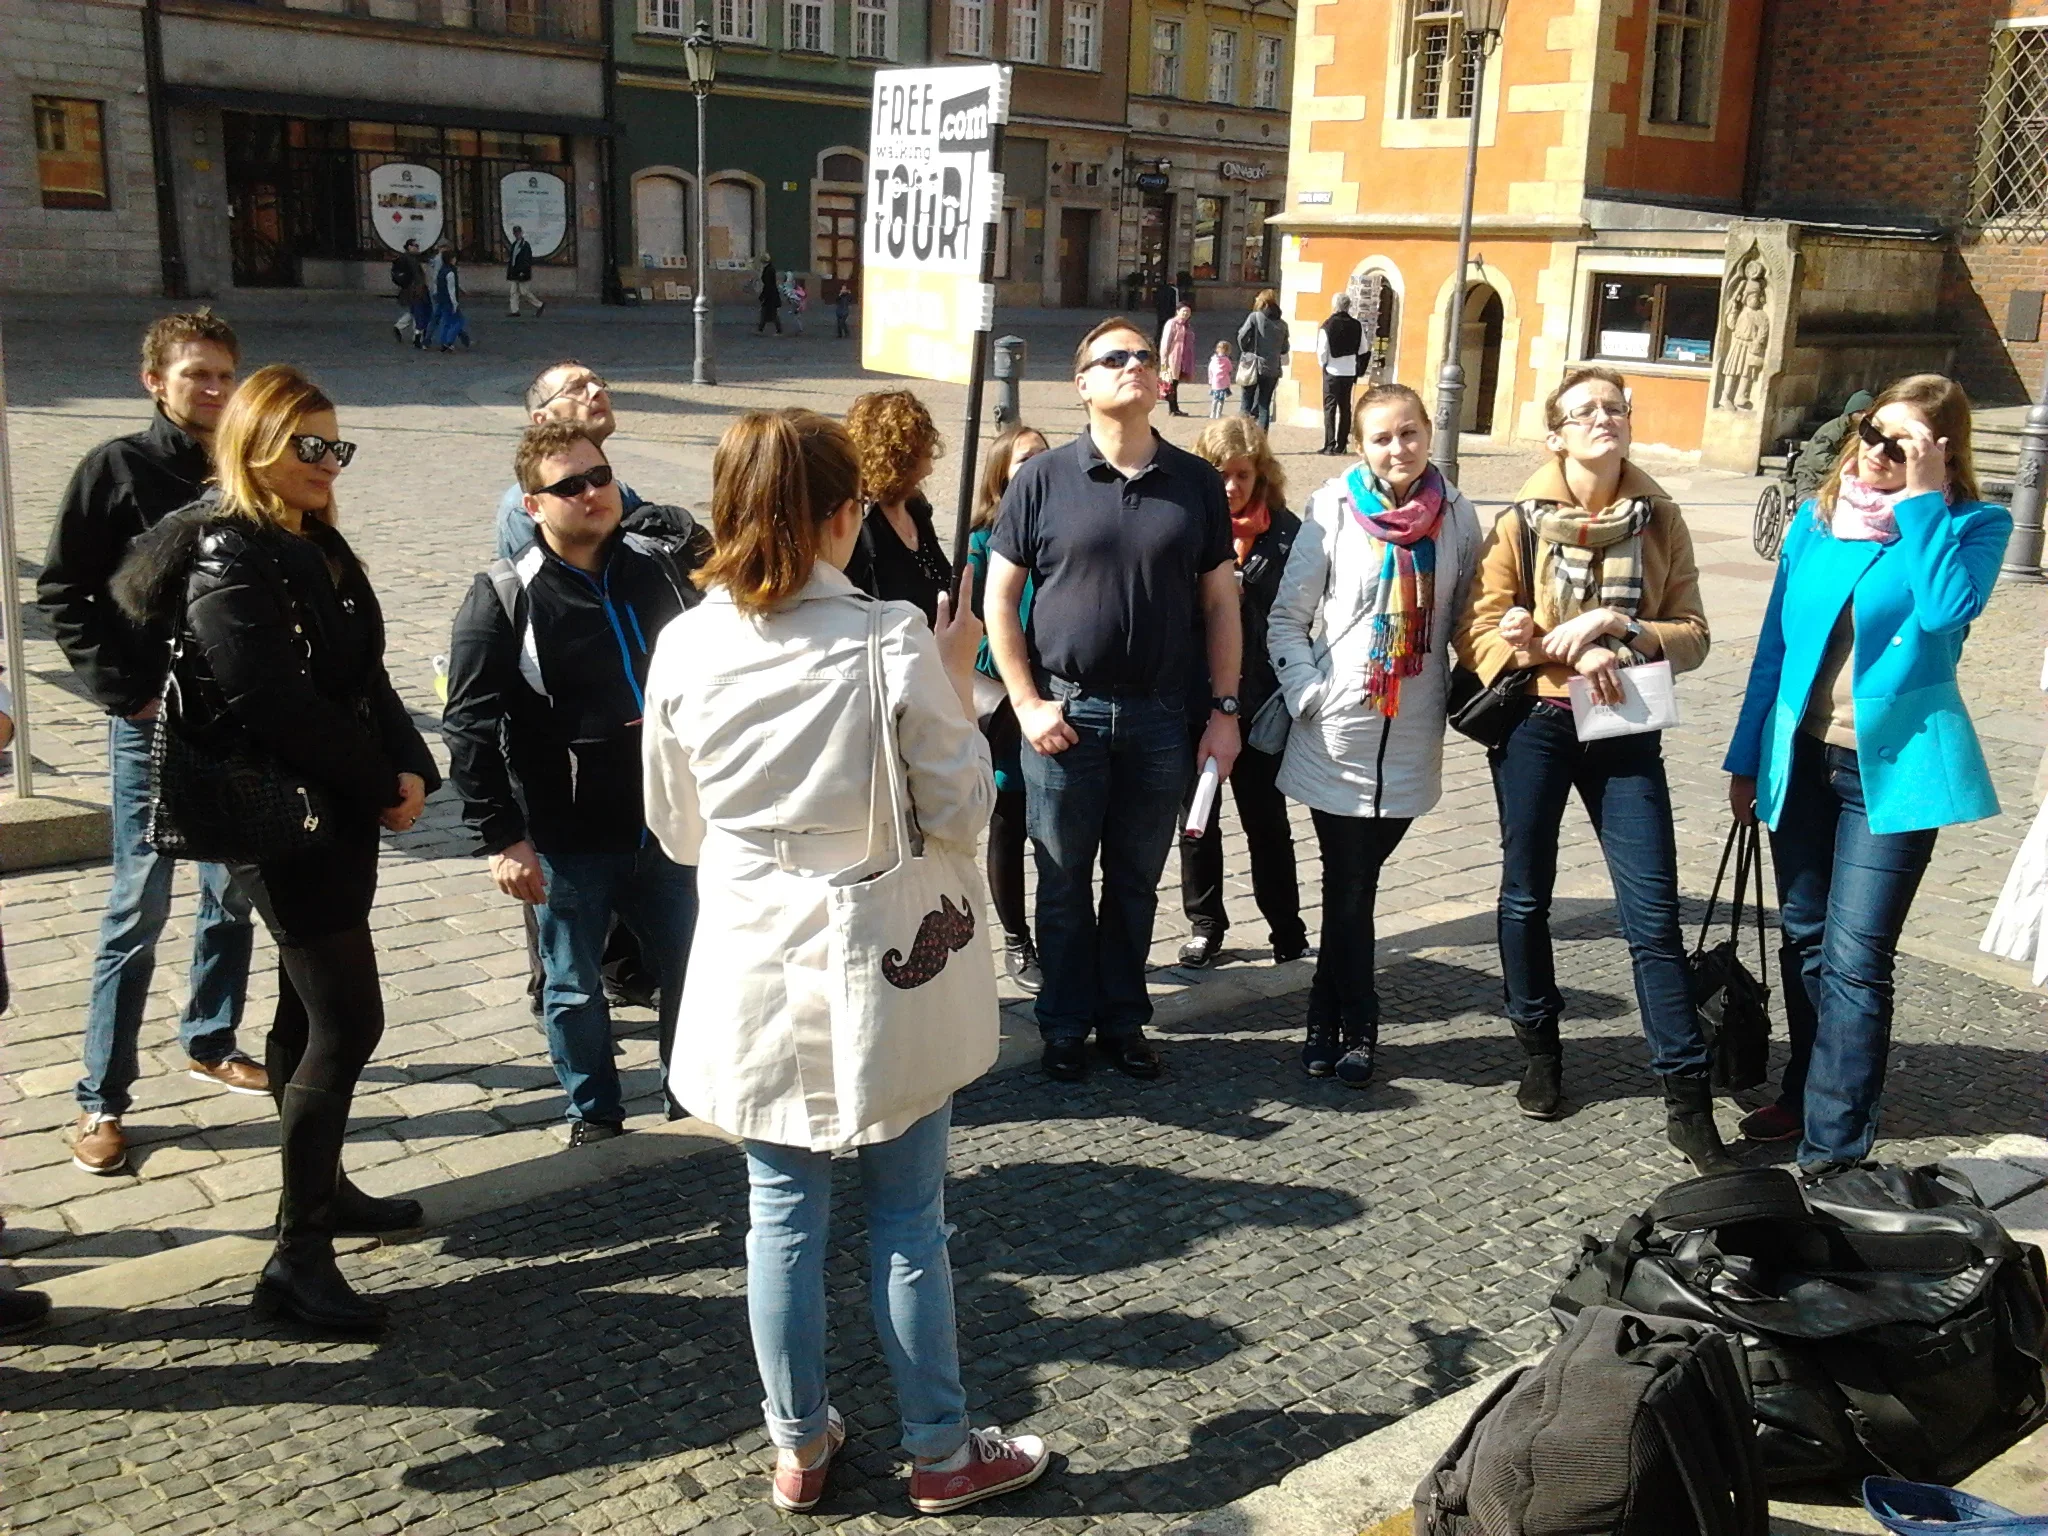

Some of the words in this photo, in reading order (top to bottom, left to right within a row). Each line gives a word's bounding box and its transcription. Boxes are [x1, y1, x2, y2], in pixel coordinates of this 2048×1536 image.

[876, 83, 934, 136] FREE
[939, 103, 988, 141] .com
[876, 140, 931, 165] walking
